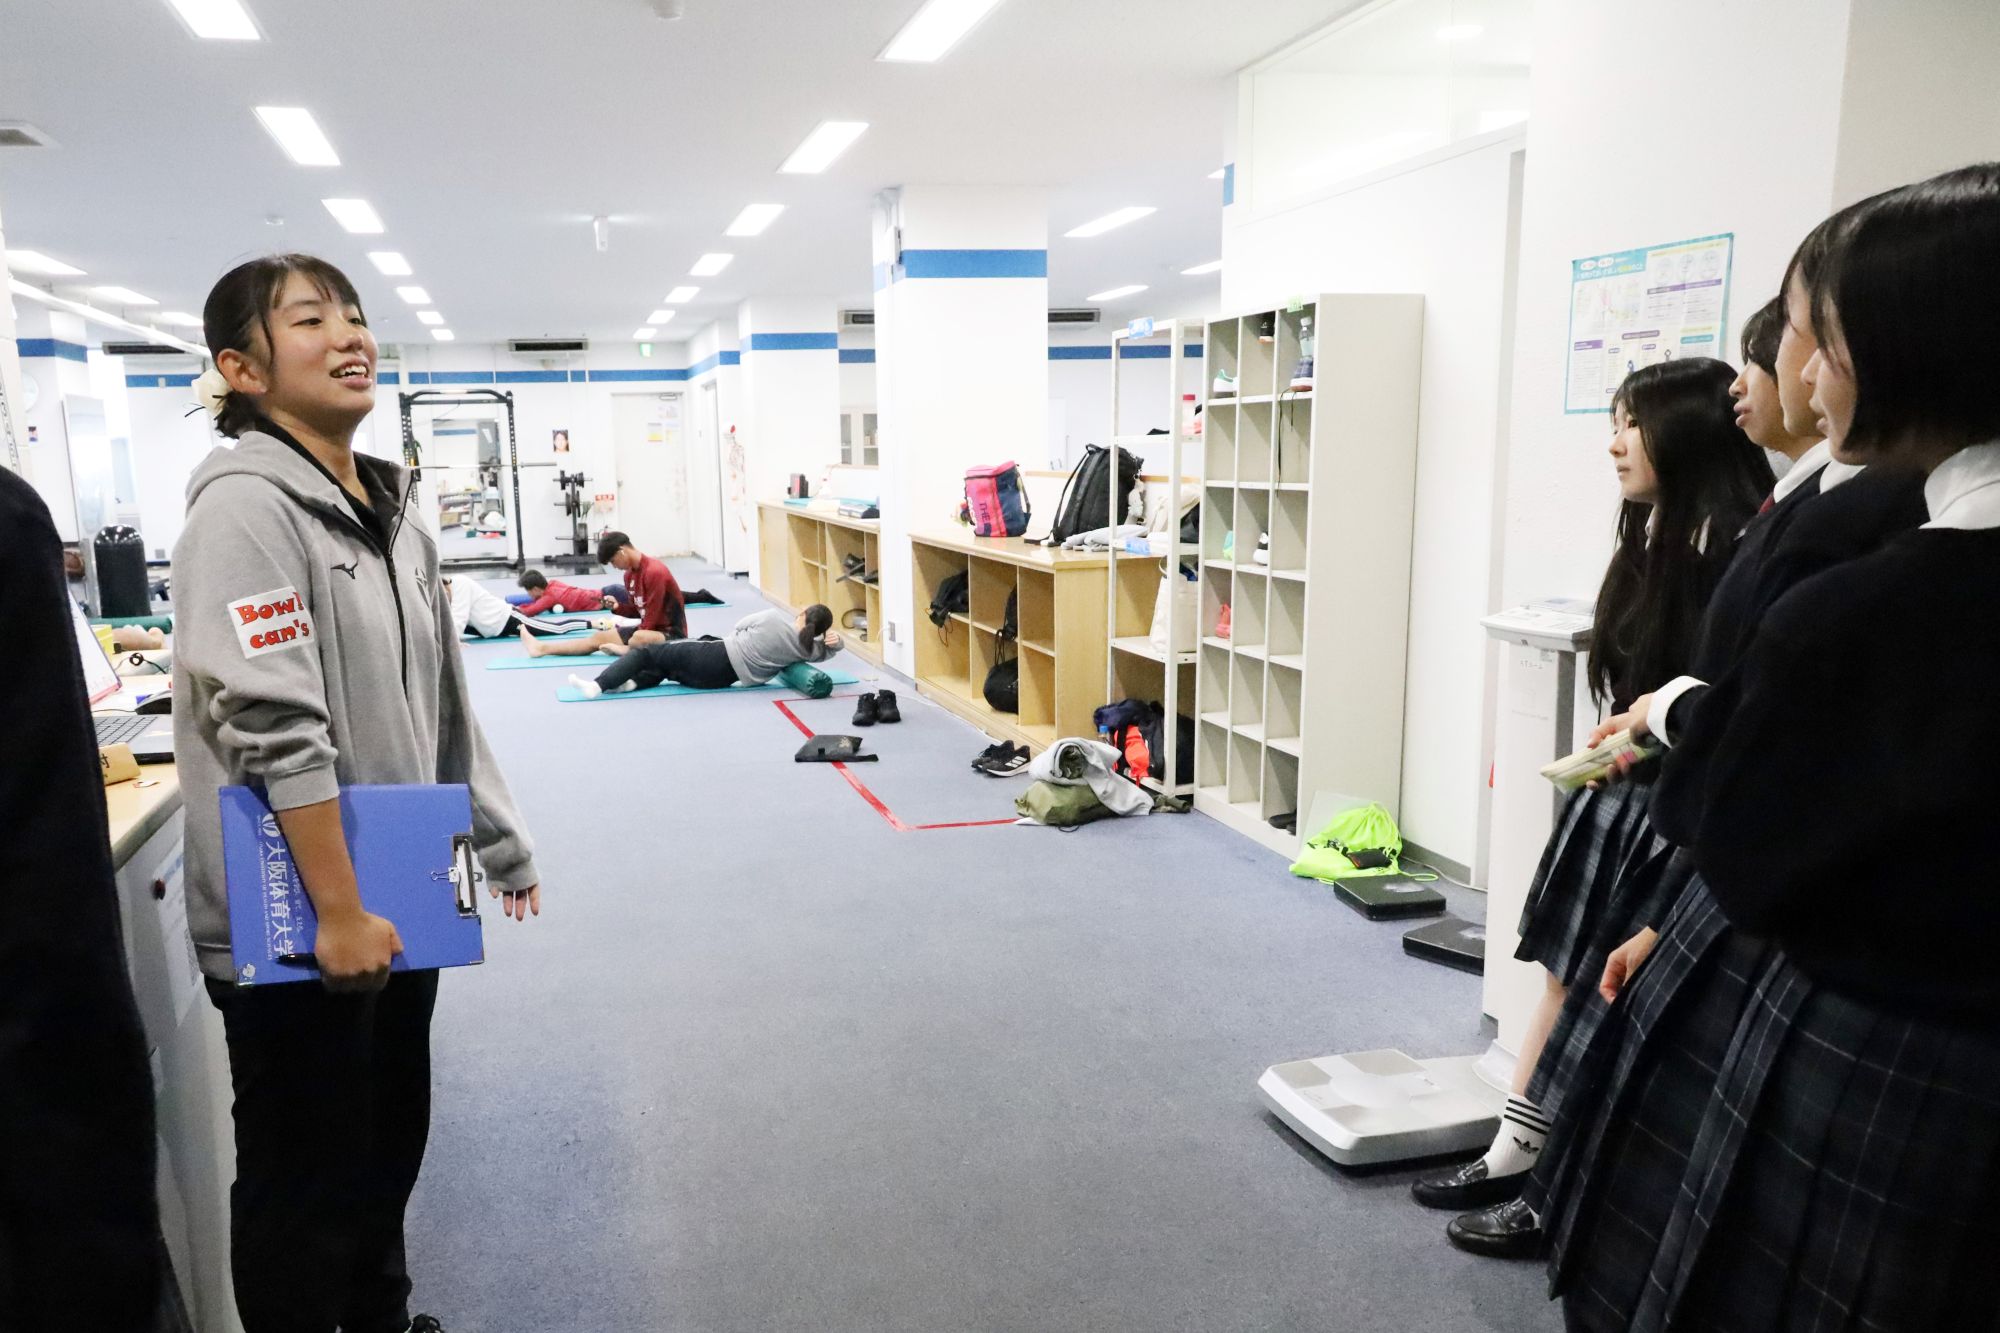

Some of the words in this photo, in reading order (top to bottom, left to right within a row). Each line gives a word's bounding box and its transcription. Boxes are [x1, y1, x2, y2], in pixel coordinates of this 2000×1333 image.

[249, 618, 310, 649] can's
[265, 841, 294, 959] 大阪体育大学
